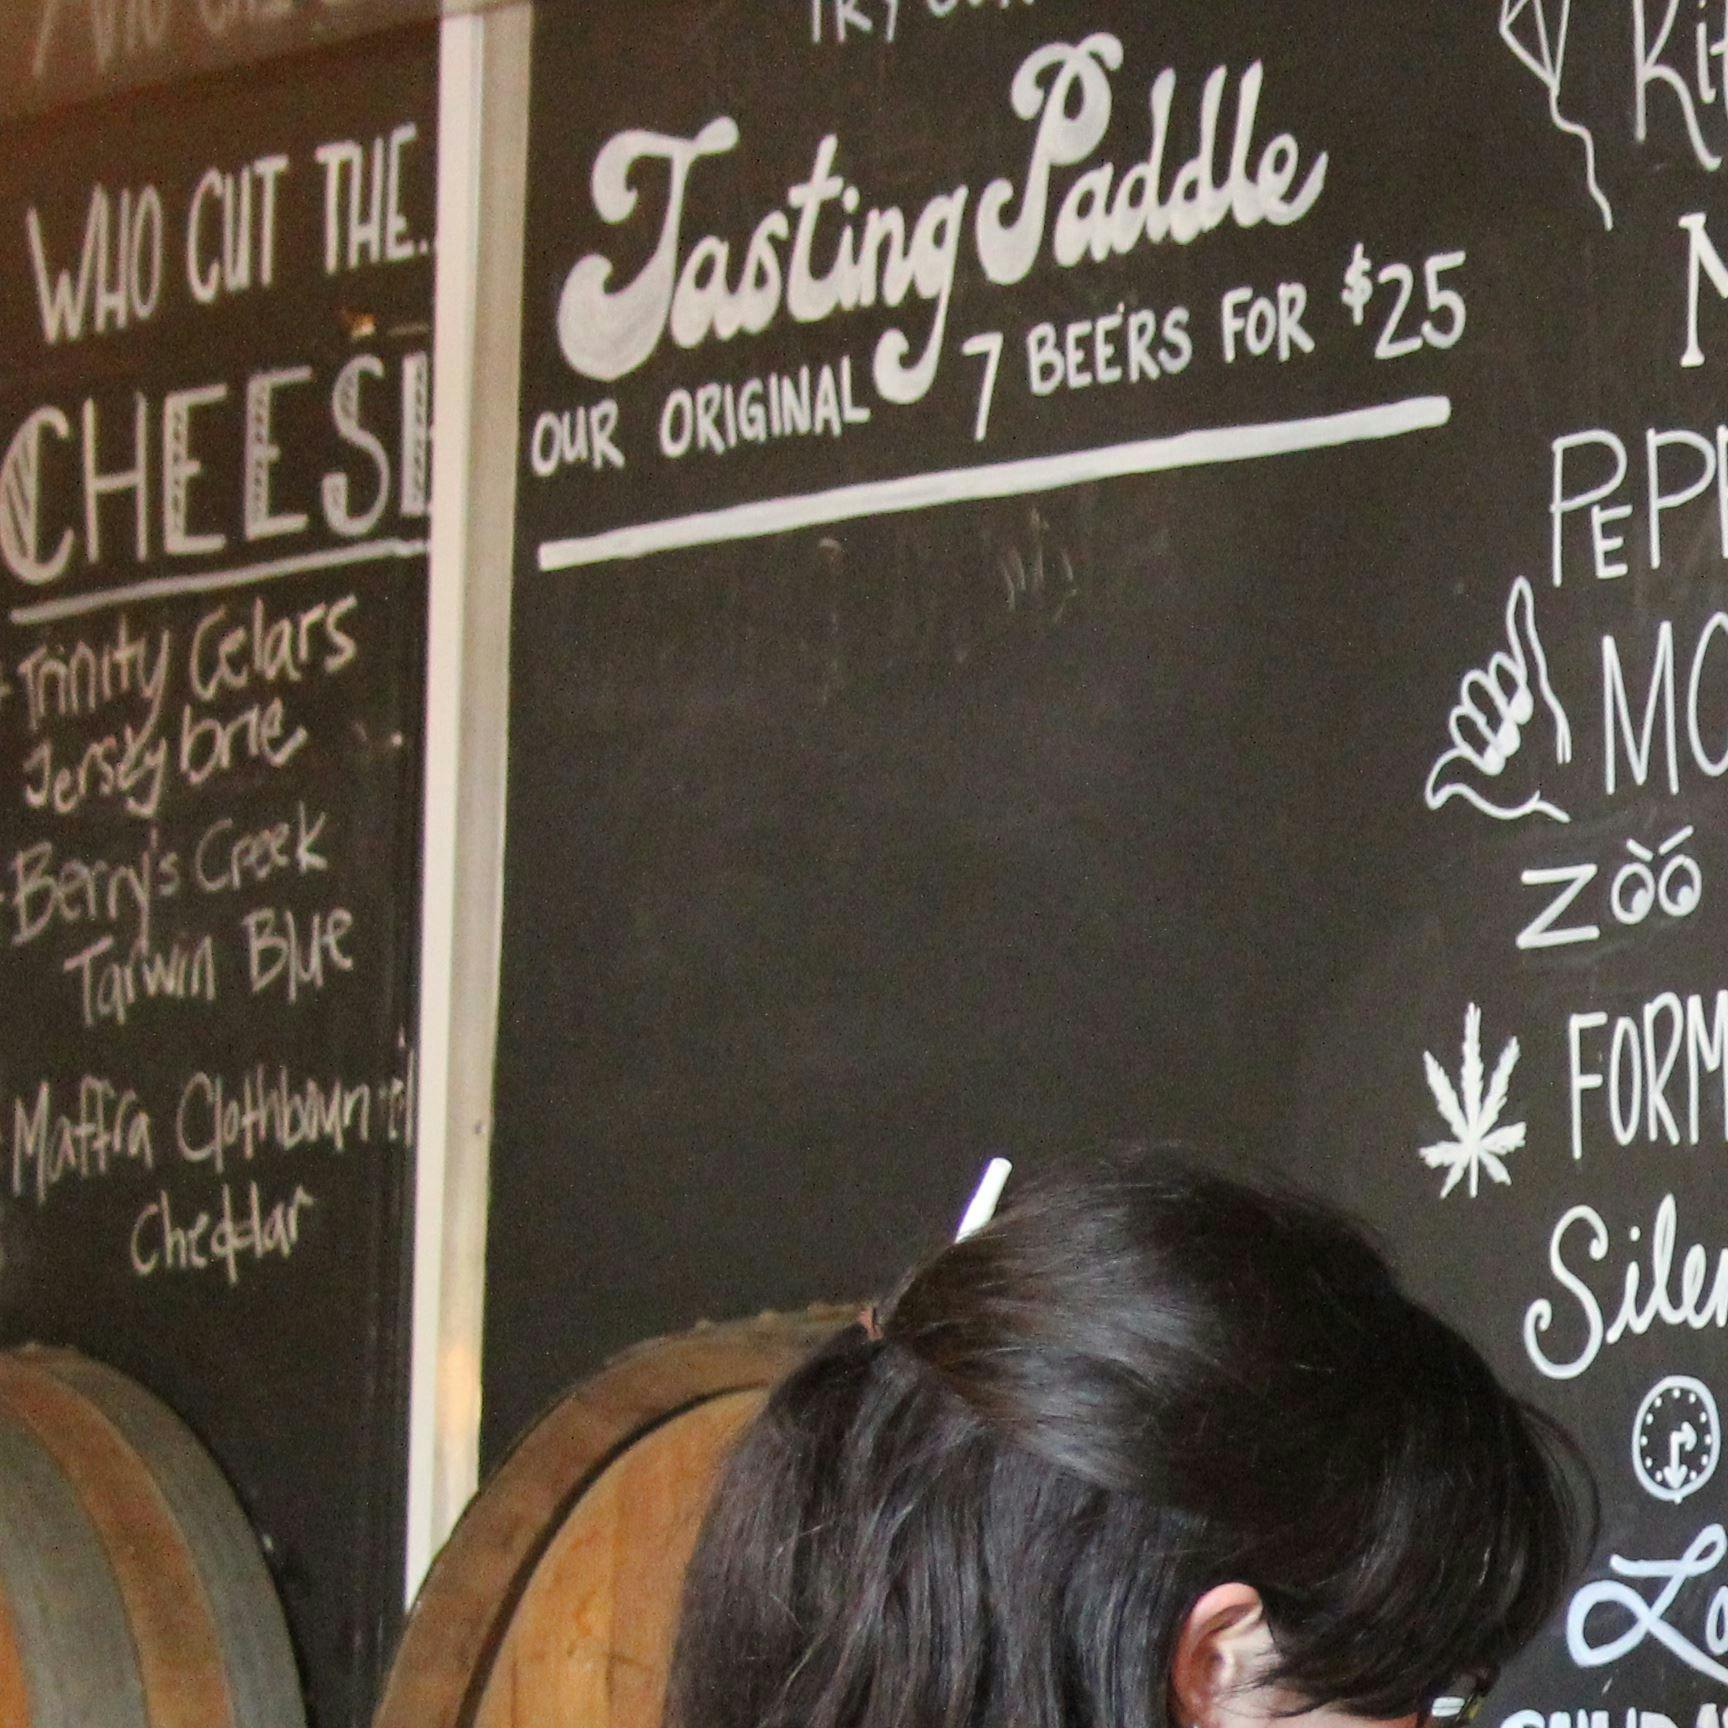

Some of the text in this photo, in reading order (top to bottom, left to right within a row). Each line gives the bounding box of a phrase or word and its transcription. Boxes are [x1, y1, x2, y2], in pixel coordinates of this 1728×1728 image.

[22, 175, 166, 350] WHO
[184, 150, 294, 306] CUT
[557, 32, 1330, 404] Tasting Paddle
[530, 241, 1467, 477] OUR ORIGINAL 7 BEERS FOR $25
